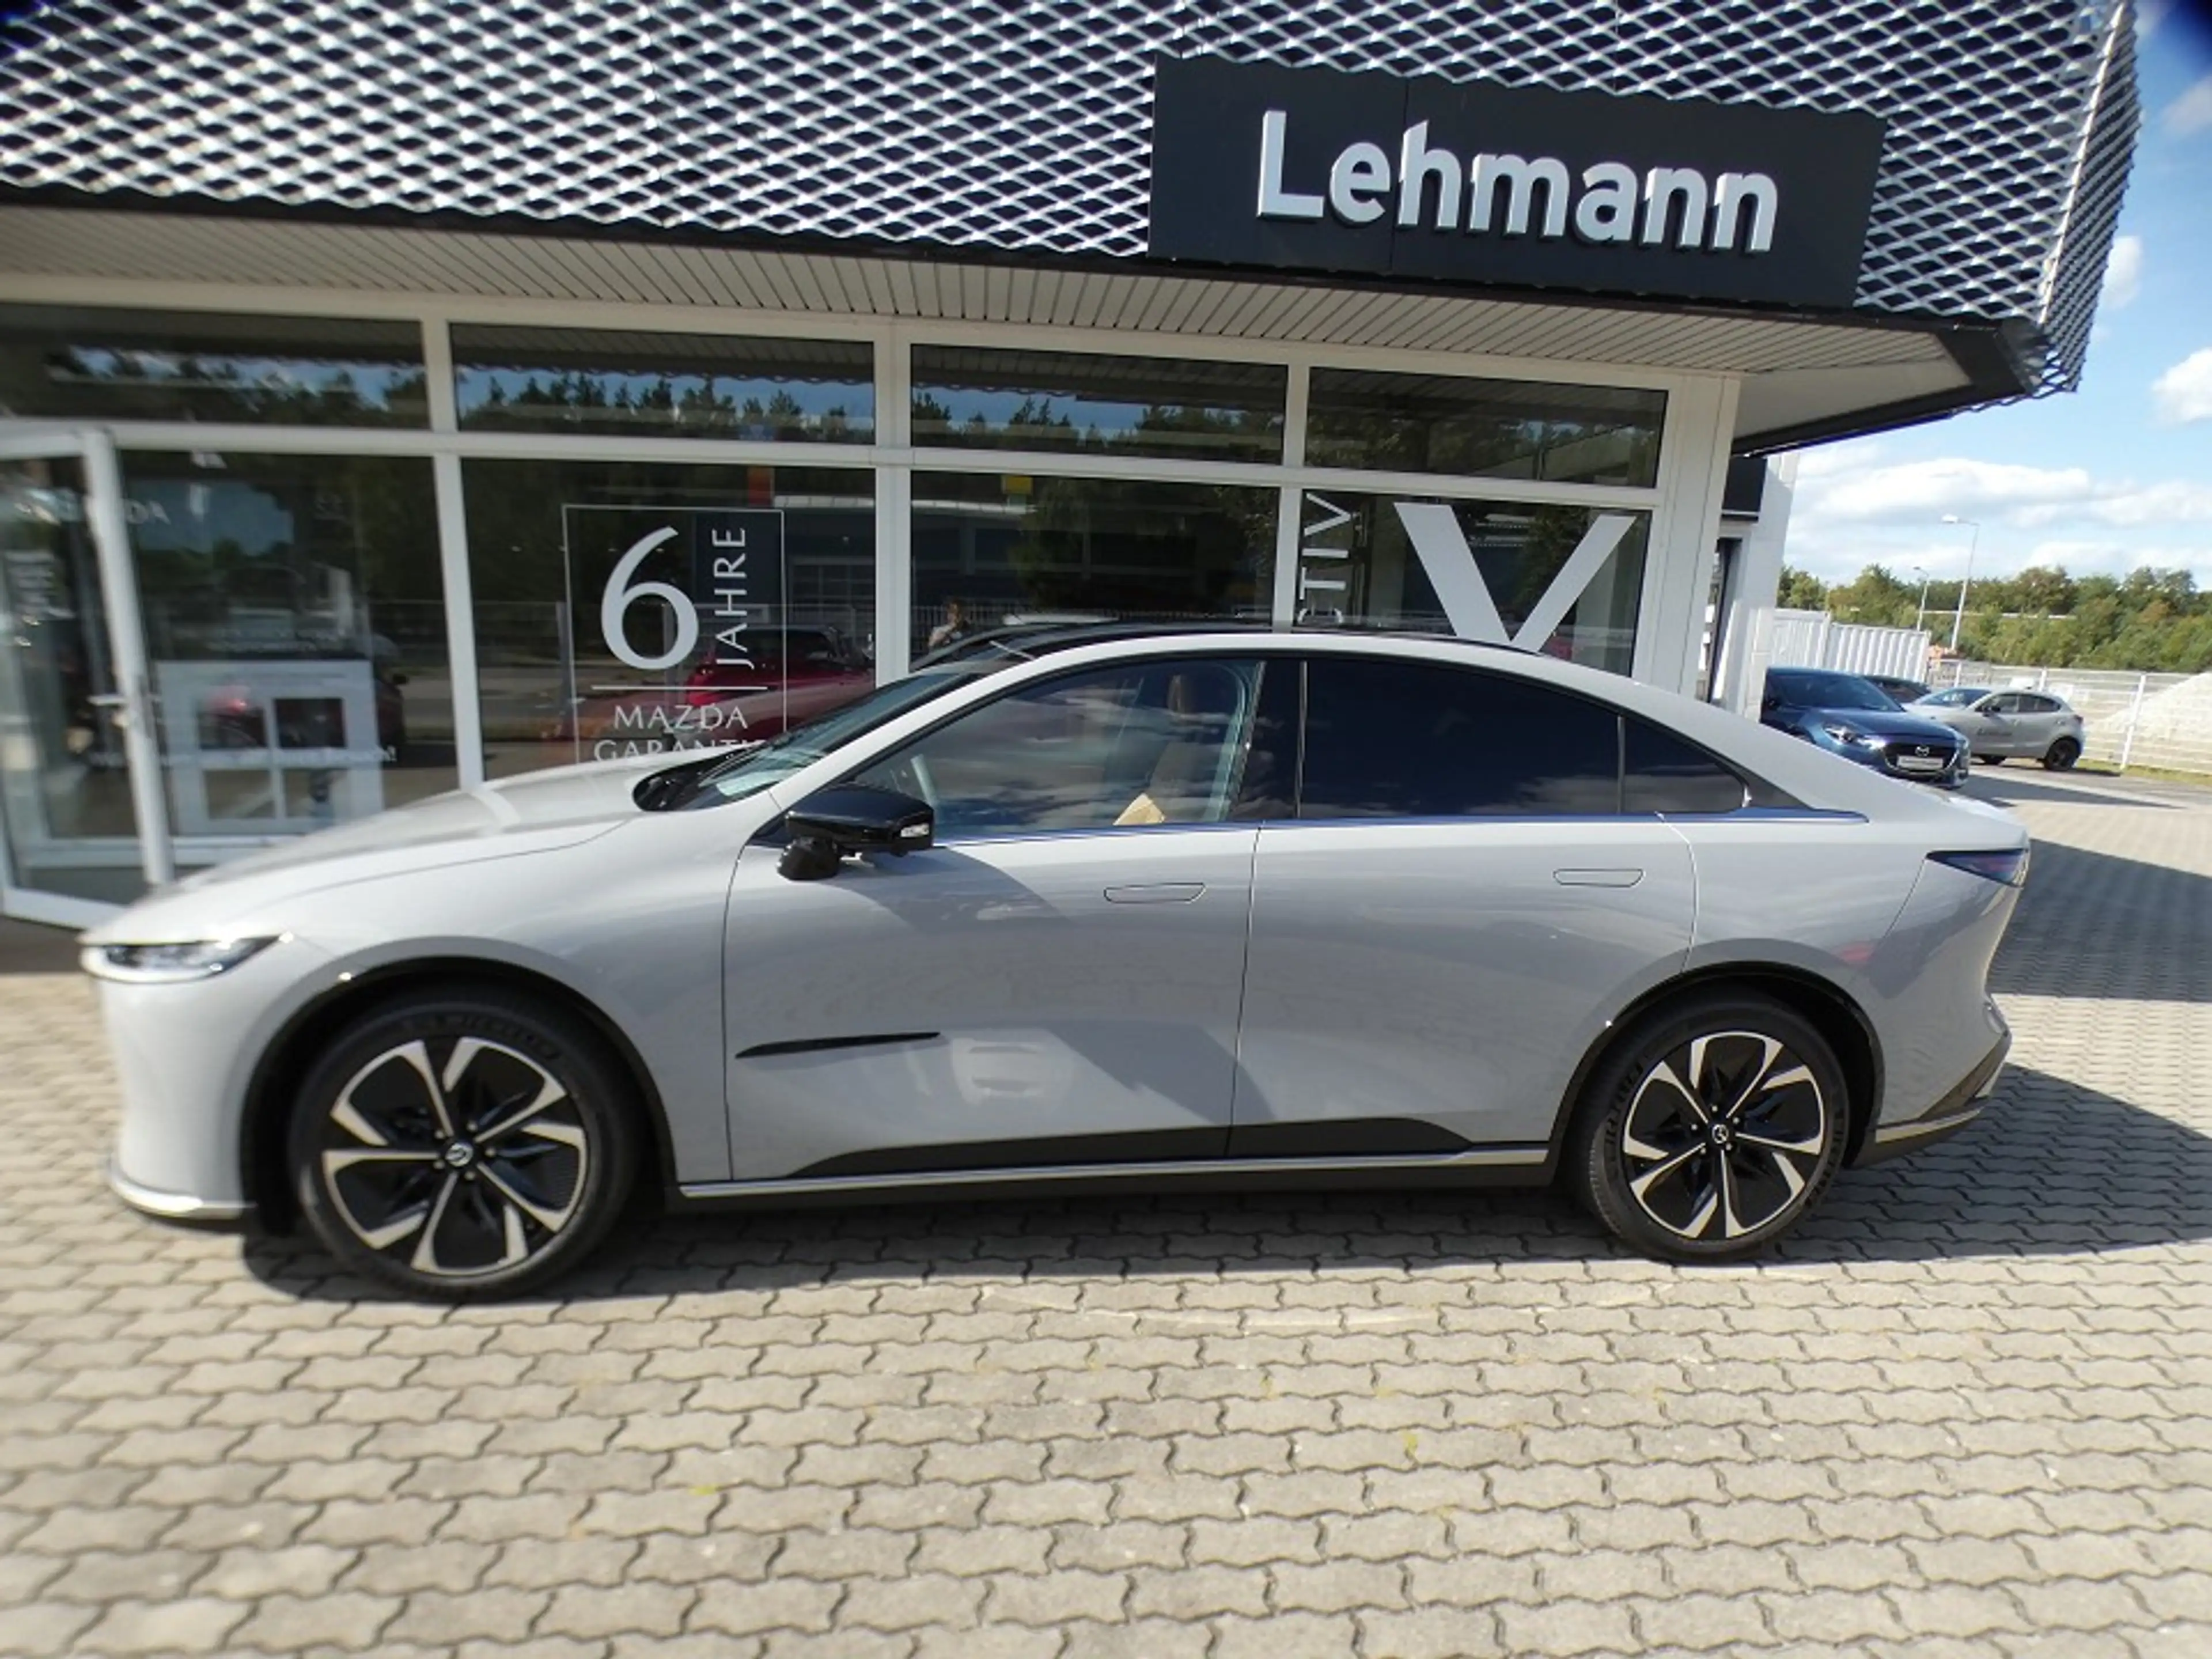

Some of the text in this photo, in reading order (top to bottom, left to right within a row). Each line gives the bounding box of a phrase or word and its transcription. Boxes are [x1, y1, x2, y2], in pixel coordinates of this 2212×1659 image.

[1257, 109, 1778, 254] Lehmann
[601, 525, 699, 671] 6
[711, 527, 755, 670] JAHRE
[613, 704, 748, 730] MAZDA
